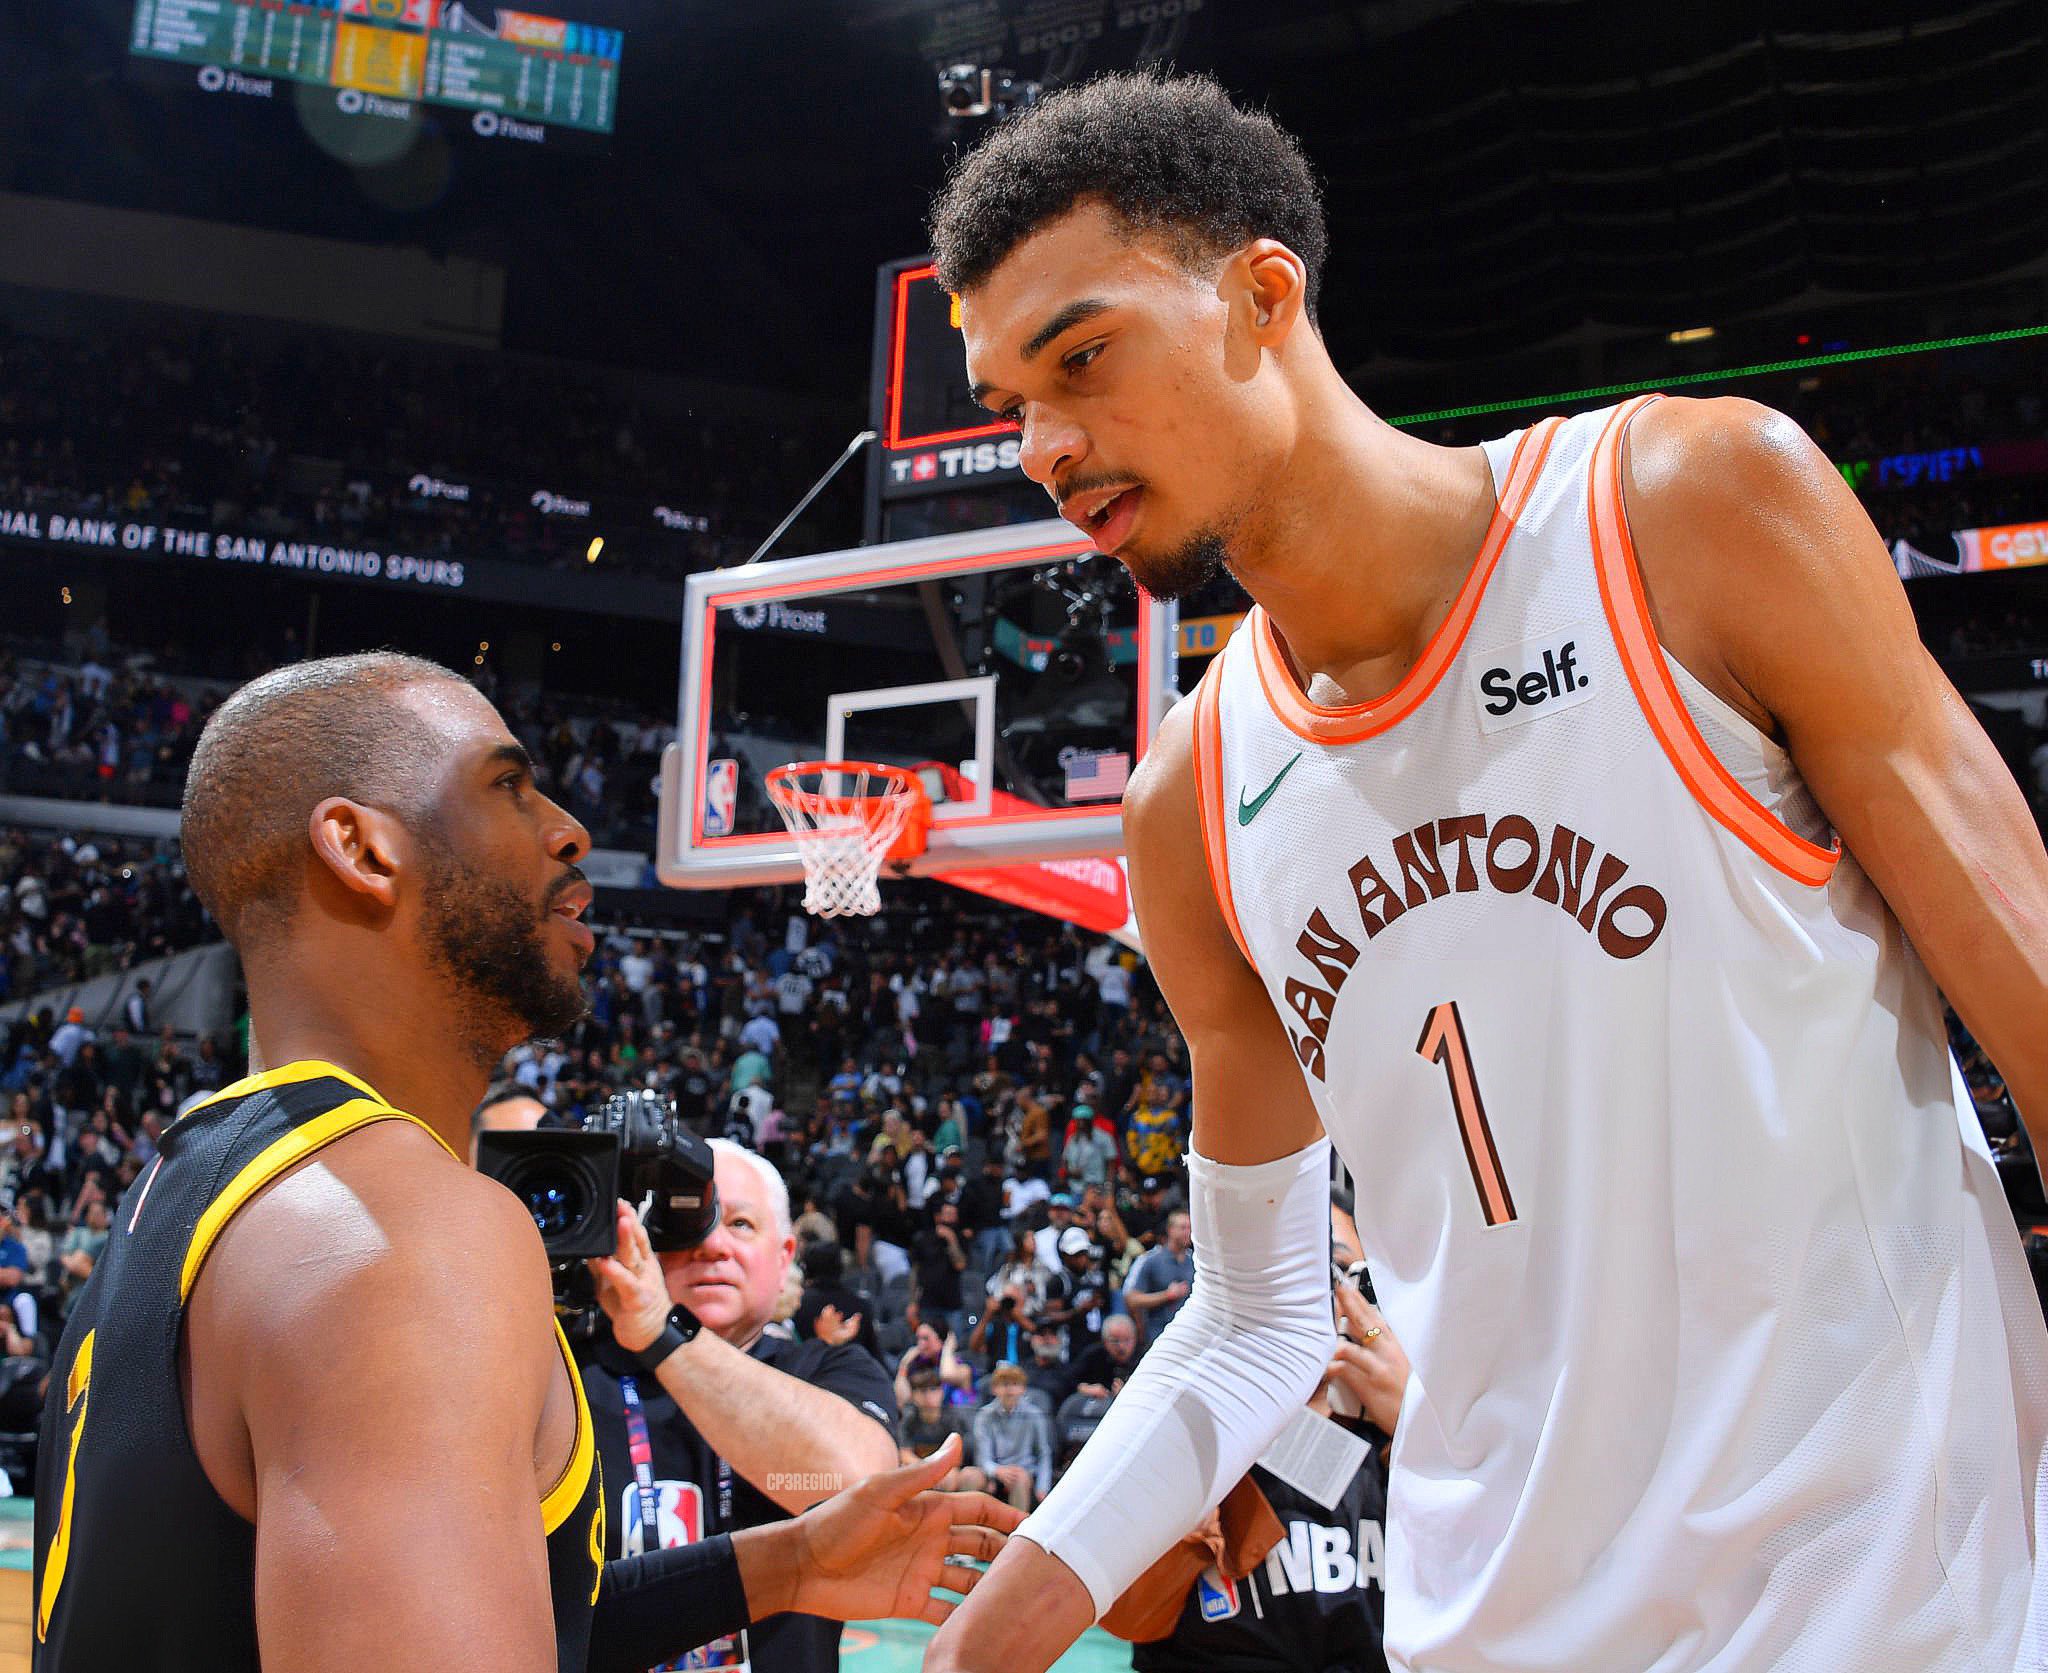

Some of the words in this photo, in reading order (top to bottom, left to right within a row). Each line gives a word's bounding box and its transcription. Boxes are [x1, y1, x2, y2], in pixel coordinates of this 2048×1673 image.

[0, 509, 41, 539] IAL
[49, 514, 116, 546] BANK
[122, 523, 157, 550] OF
[163, 527, 210, 558] THE
[215, 533, 266, 563] SAN
[270, 541, 381, 577] ANTONIO
[385, 554, 464, 587] SPURS
[1480, 641, 1589, 716] Self.
[1285, 906, 1361, 1083] SAN
[1347, 813, 1668, 960] ANTONIO
[1415, 1000, 1519, 1227] 1
[1265, 1520, 1386, 1597] NBA
